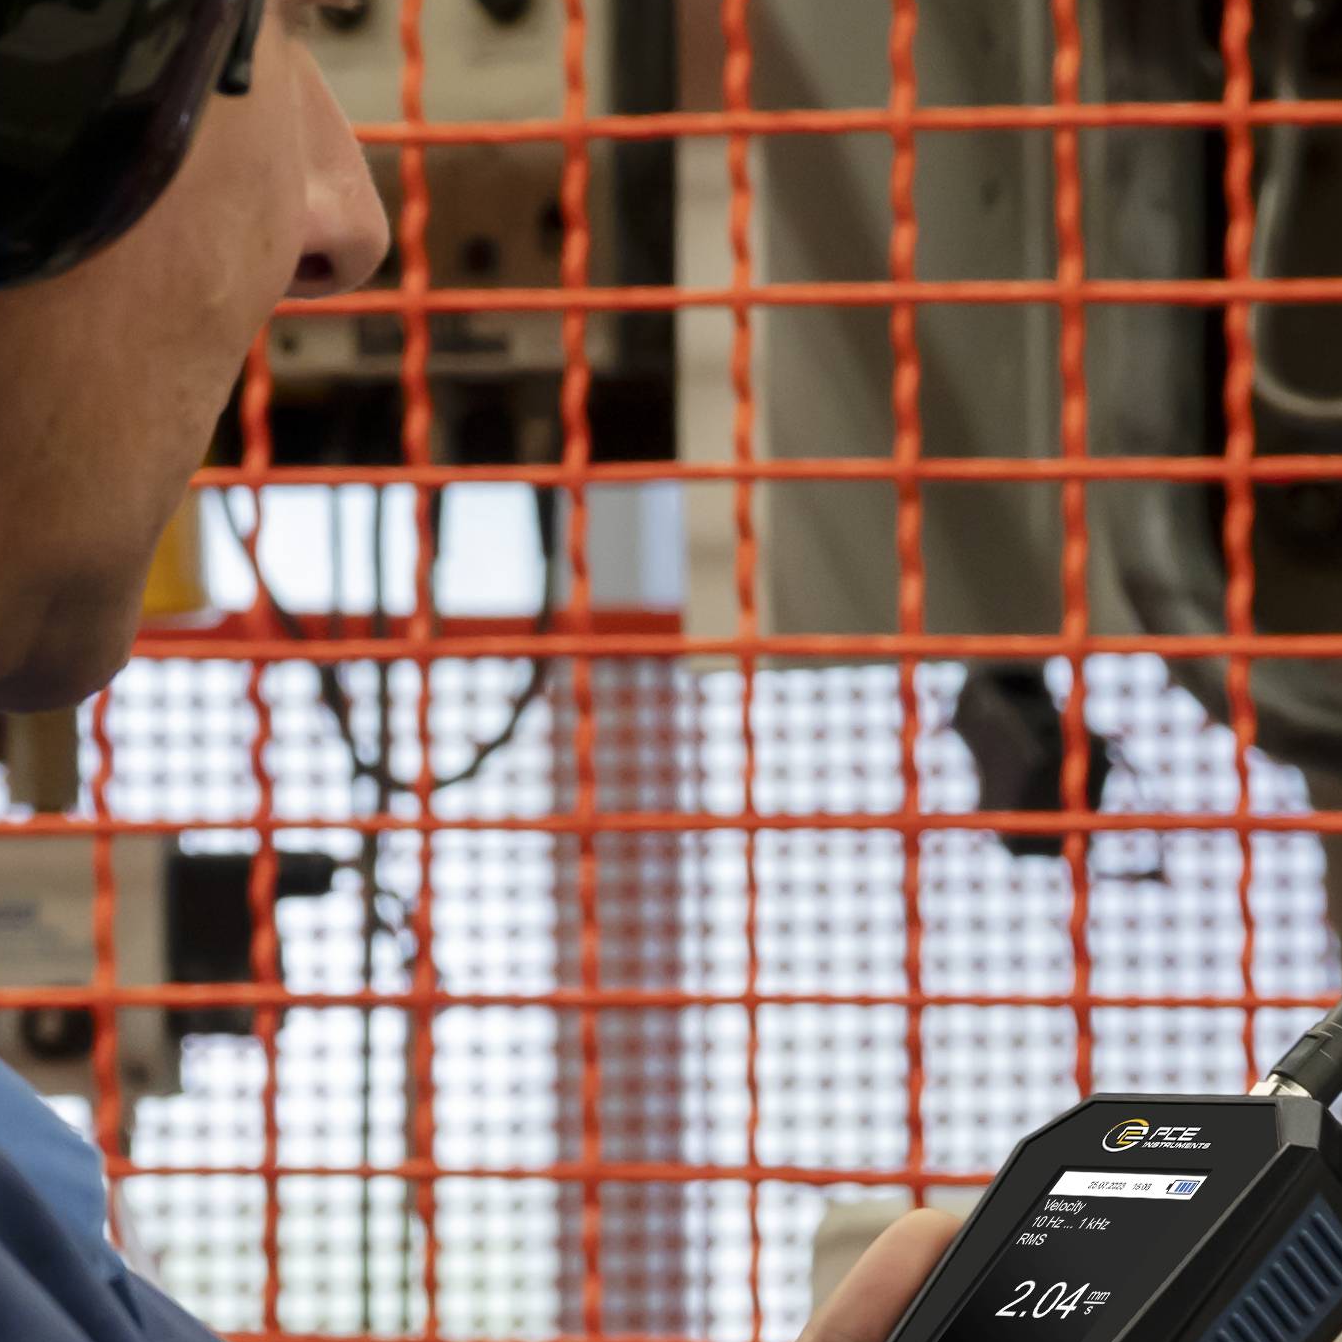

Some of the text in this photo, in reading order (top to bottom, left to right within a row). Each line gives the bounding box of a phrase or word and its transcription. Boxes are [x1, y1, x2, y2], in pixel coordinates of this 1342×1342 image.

[1148, 1126, 1202, 1141] PCE
[1141, 1141, 1212, 1150] INSTRUMENTS
[1044, 1199, 1087, 1215] Velocity
[1032, 1216, 1048, 1228] 10
[1079, 1217, 1088, 1229] 1
[1085, 1217, 1111, 1230] kHz
[1016, 1233, 1048, 1246] RMS
[994, 1280, 1091, 1320] 2.04
